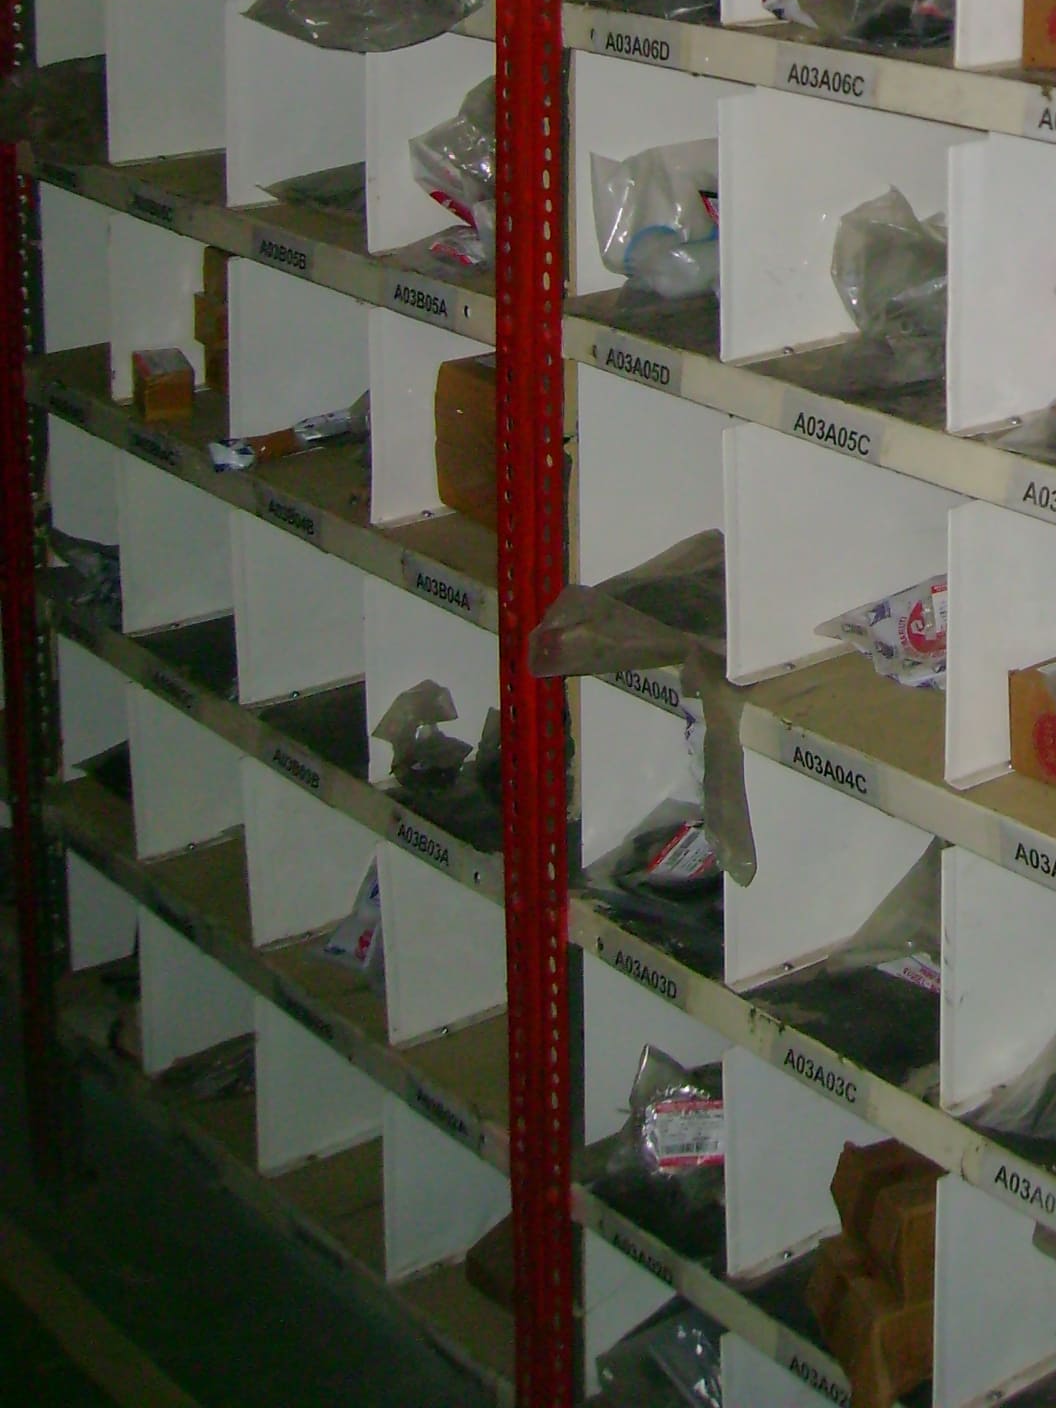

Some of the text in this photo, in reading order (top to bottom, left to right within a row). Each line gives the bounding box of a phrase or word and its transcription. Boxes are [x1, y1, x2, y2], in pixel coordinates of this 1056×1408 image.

[604, 29, 671, 63] A03A06D
[786, 61, 866, 99] A03A06C
[392, 283, 449, 320] A03B05A
[605, 346, 671, 388] A03A05D
[792, 410, 872, 458] A03A05C
[416, 571, 472, 613] A03B04A
[792, 744, 869, 797] A03A04C
[395, 822, 451, 868] A03B03A
[615, 948, 679, 1002] A03A03D
[783, 1047, 859, 1107] A03A03C
